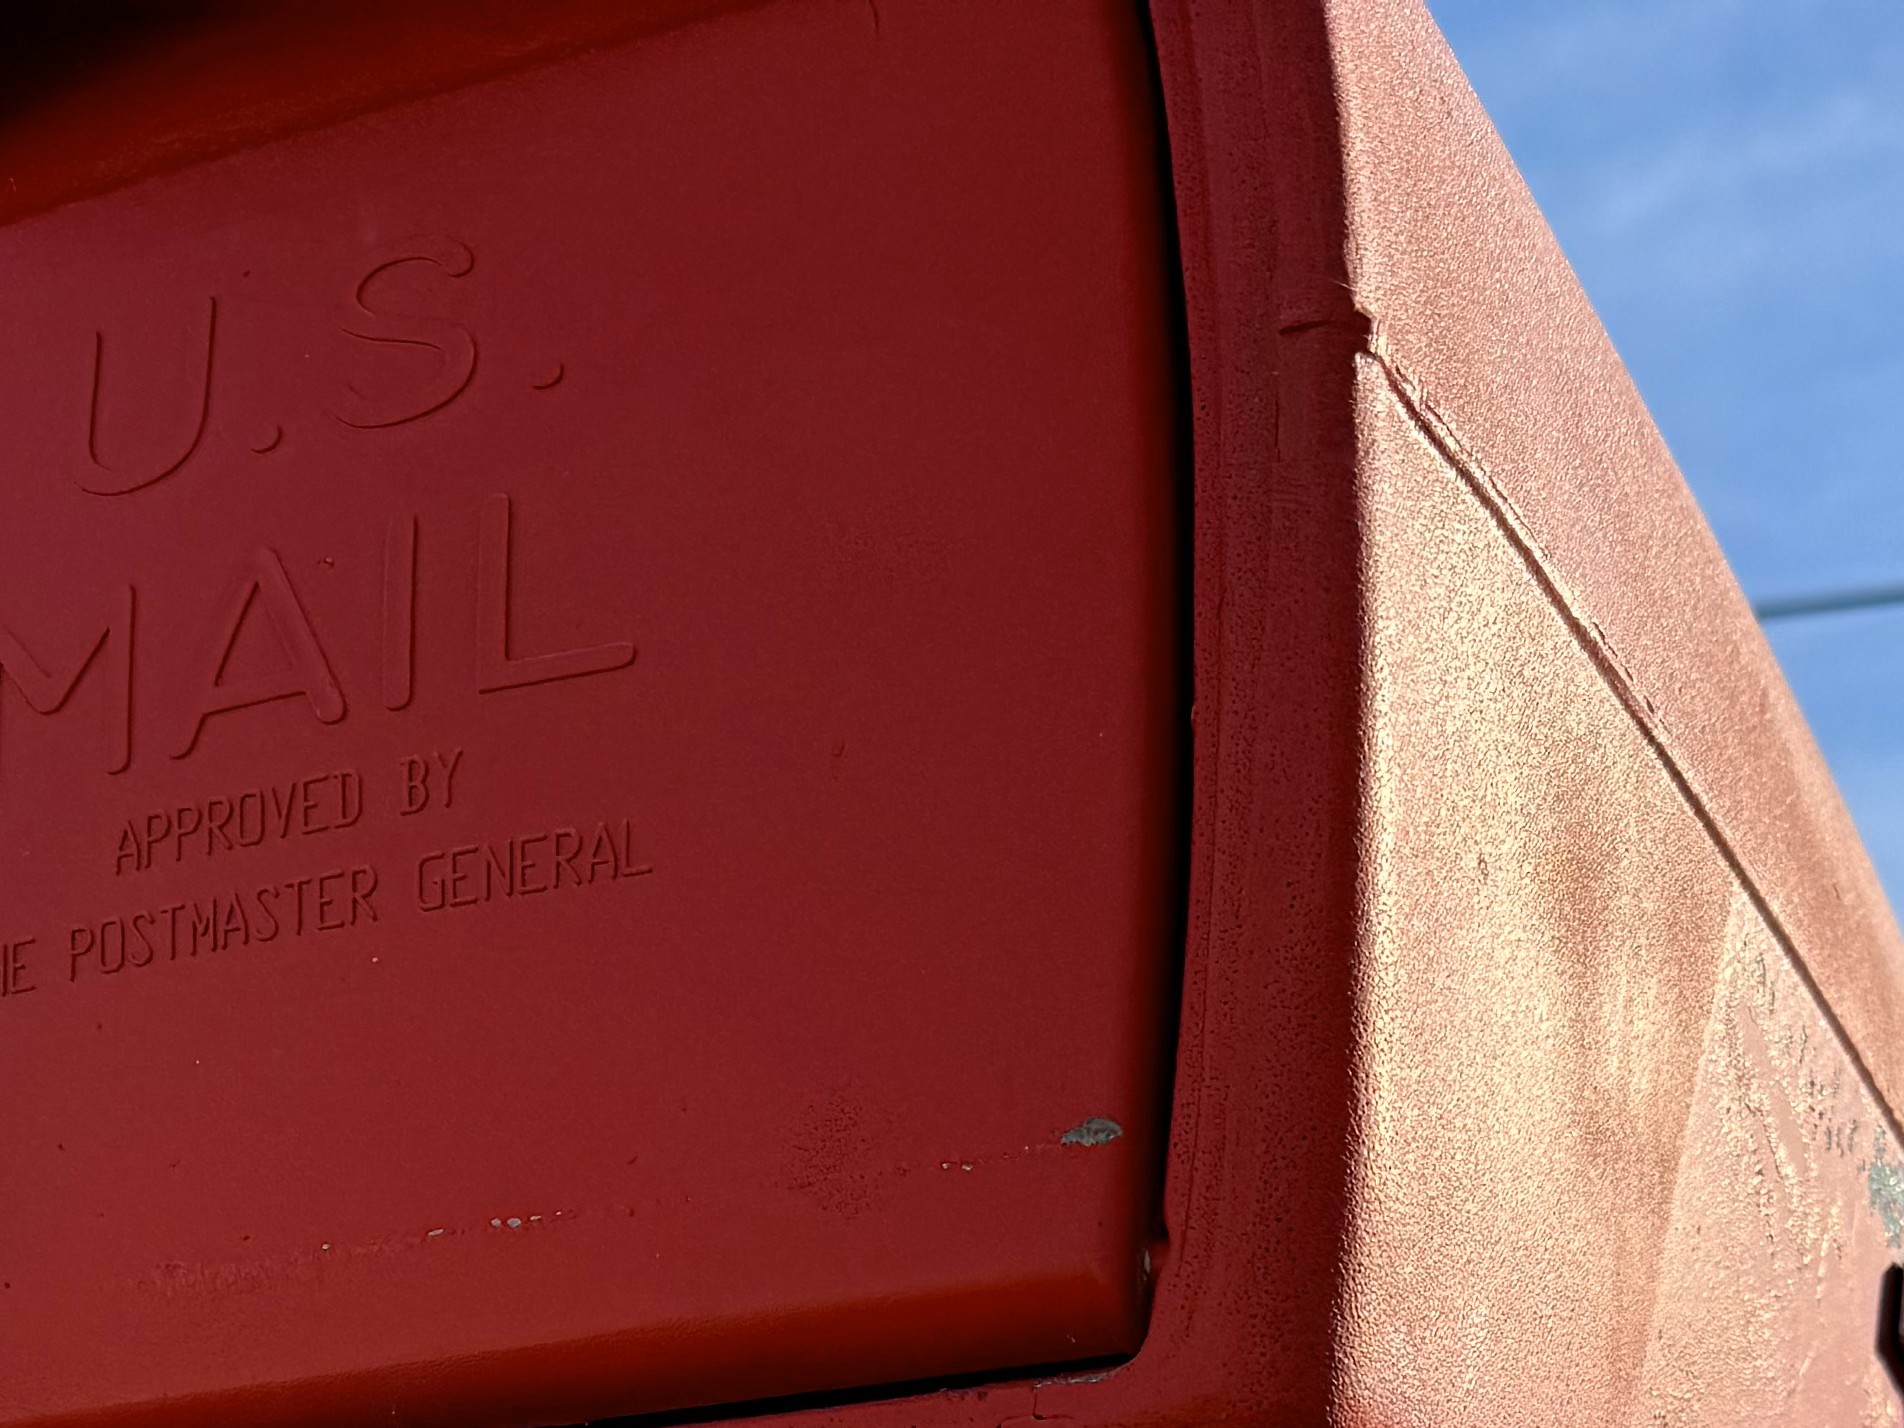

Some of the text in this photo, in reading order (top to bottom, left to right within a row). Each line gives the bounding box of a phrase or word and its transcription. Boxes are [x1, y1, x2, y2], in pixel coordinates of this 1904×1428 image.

[70, 234, 566, 498] U.S.
[114, 747, 464, 876] APPROVED BY
[68, 865, 380, 983] POSTMASTER
[414, 818, 654, 914] GENERAL
